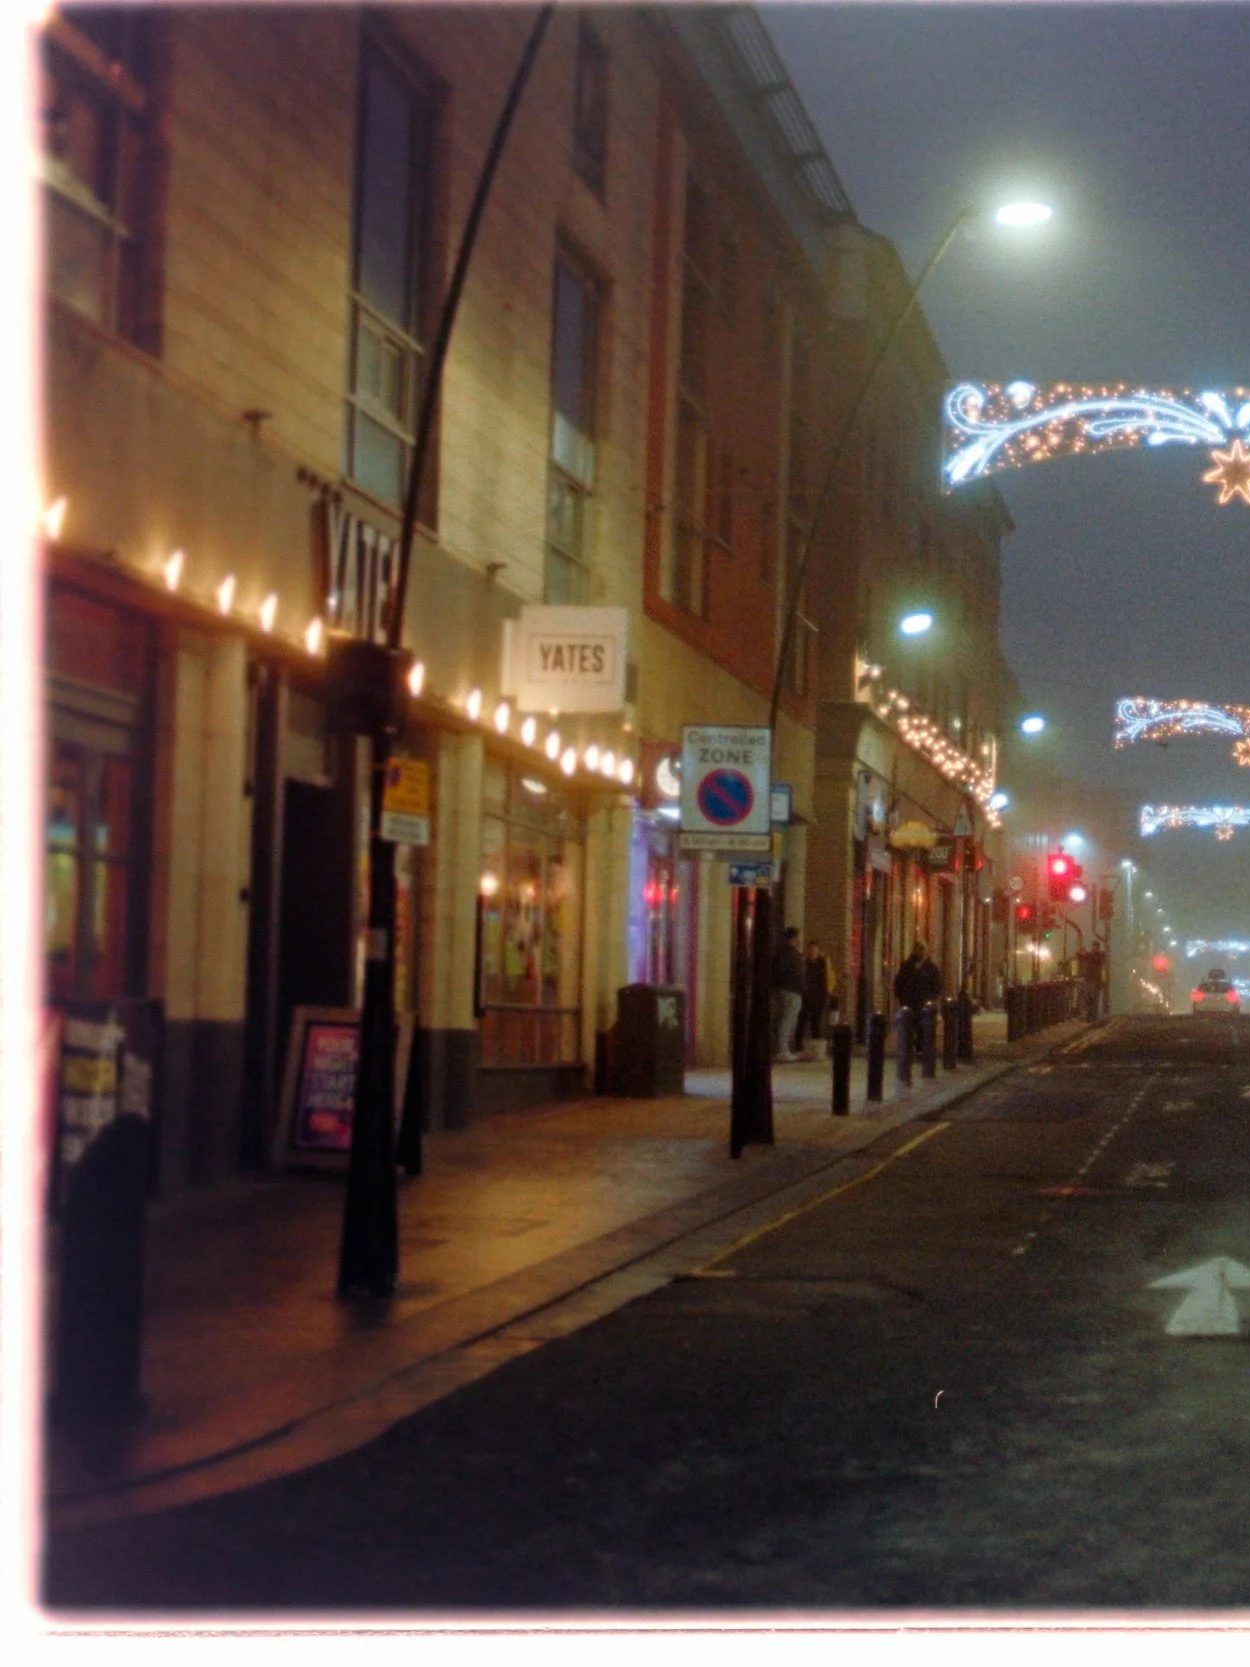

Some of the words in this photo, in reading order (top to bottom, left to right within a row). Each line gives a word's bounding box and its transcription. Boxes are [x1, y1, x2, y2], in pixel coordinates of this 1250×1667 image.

[540, 643, 605, 673] YATES
[687, 732, 766, 746] Controlled
[699, 748, 753, 764] ZONE
